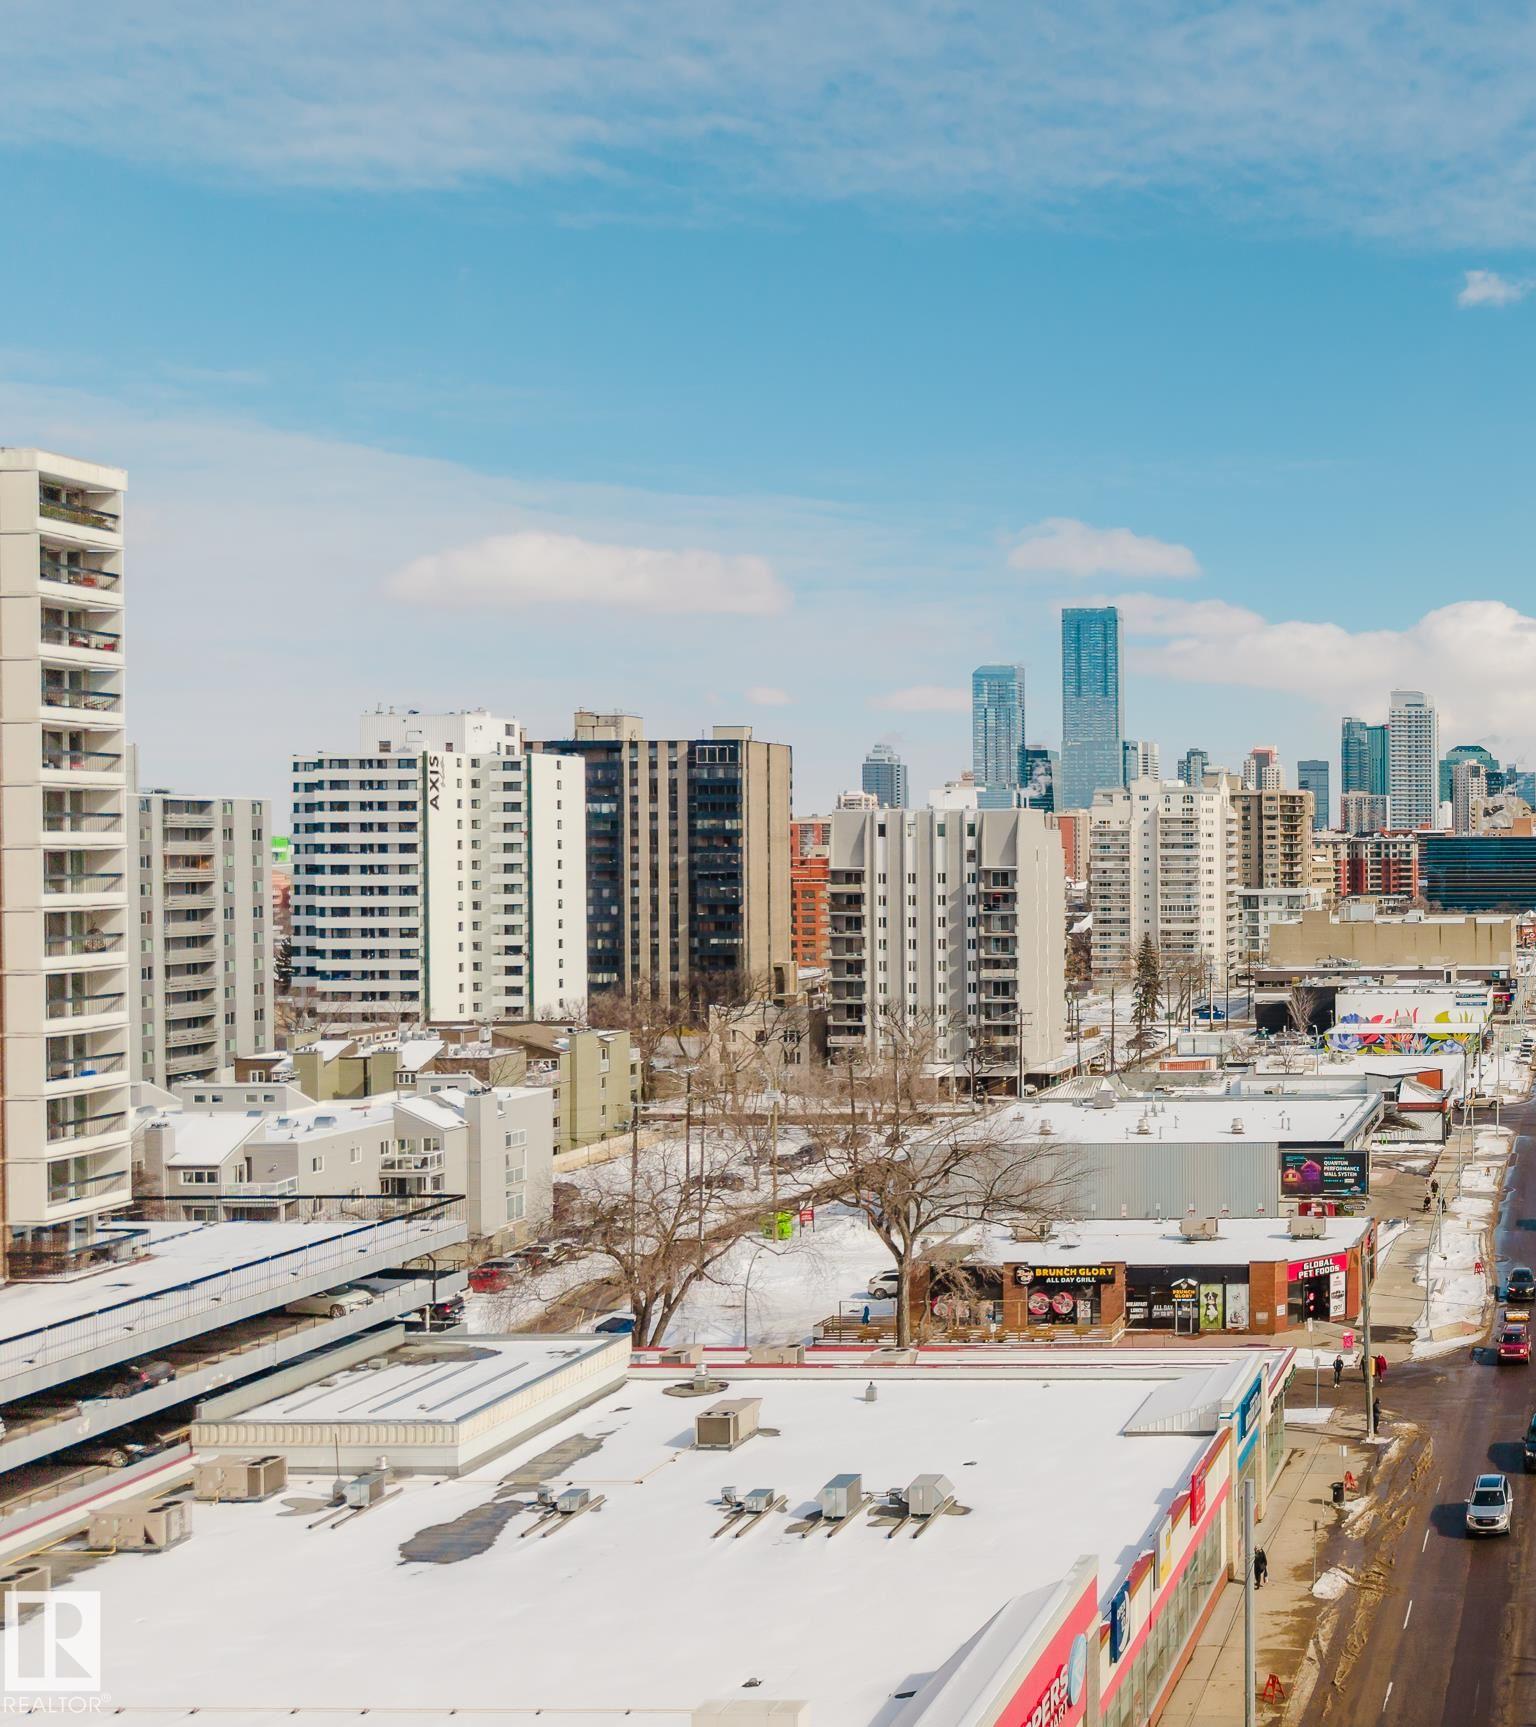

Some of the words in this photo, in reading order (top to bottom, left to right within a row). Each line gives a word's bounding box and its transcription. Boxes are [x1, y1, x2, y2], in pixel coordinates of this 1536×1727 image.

[429, 755, 440, 811] AXIS
[1035, 1267, 1077, 1276] BRUNCH
[1080, 1267, 1113, 1276] GLORY
[1303, 1258, 1334, 1270] GLOBAL
[1298, 1269, 1314, 1280] PET
[1315, 1265, 1340, 1276] FOODS
[1026, 1663, 1069, 1727] PERS
